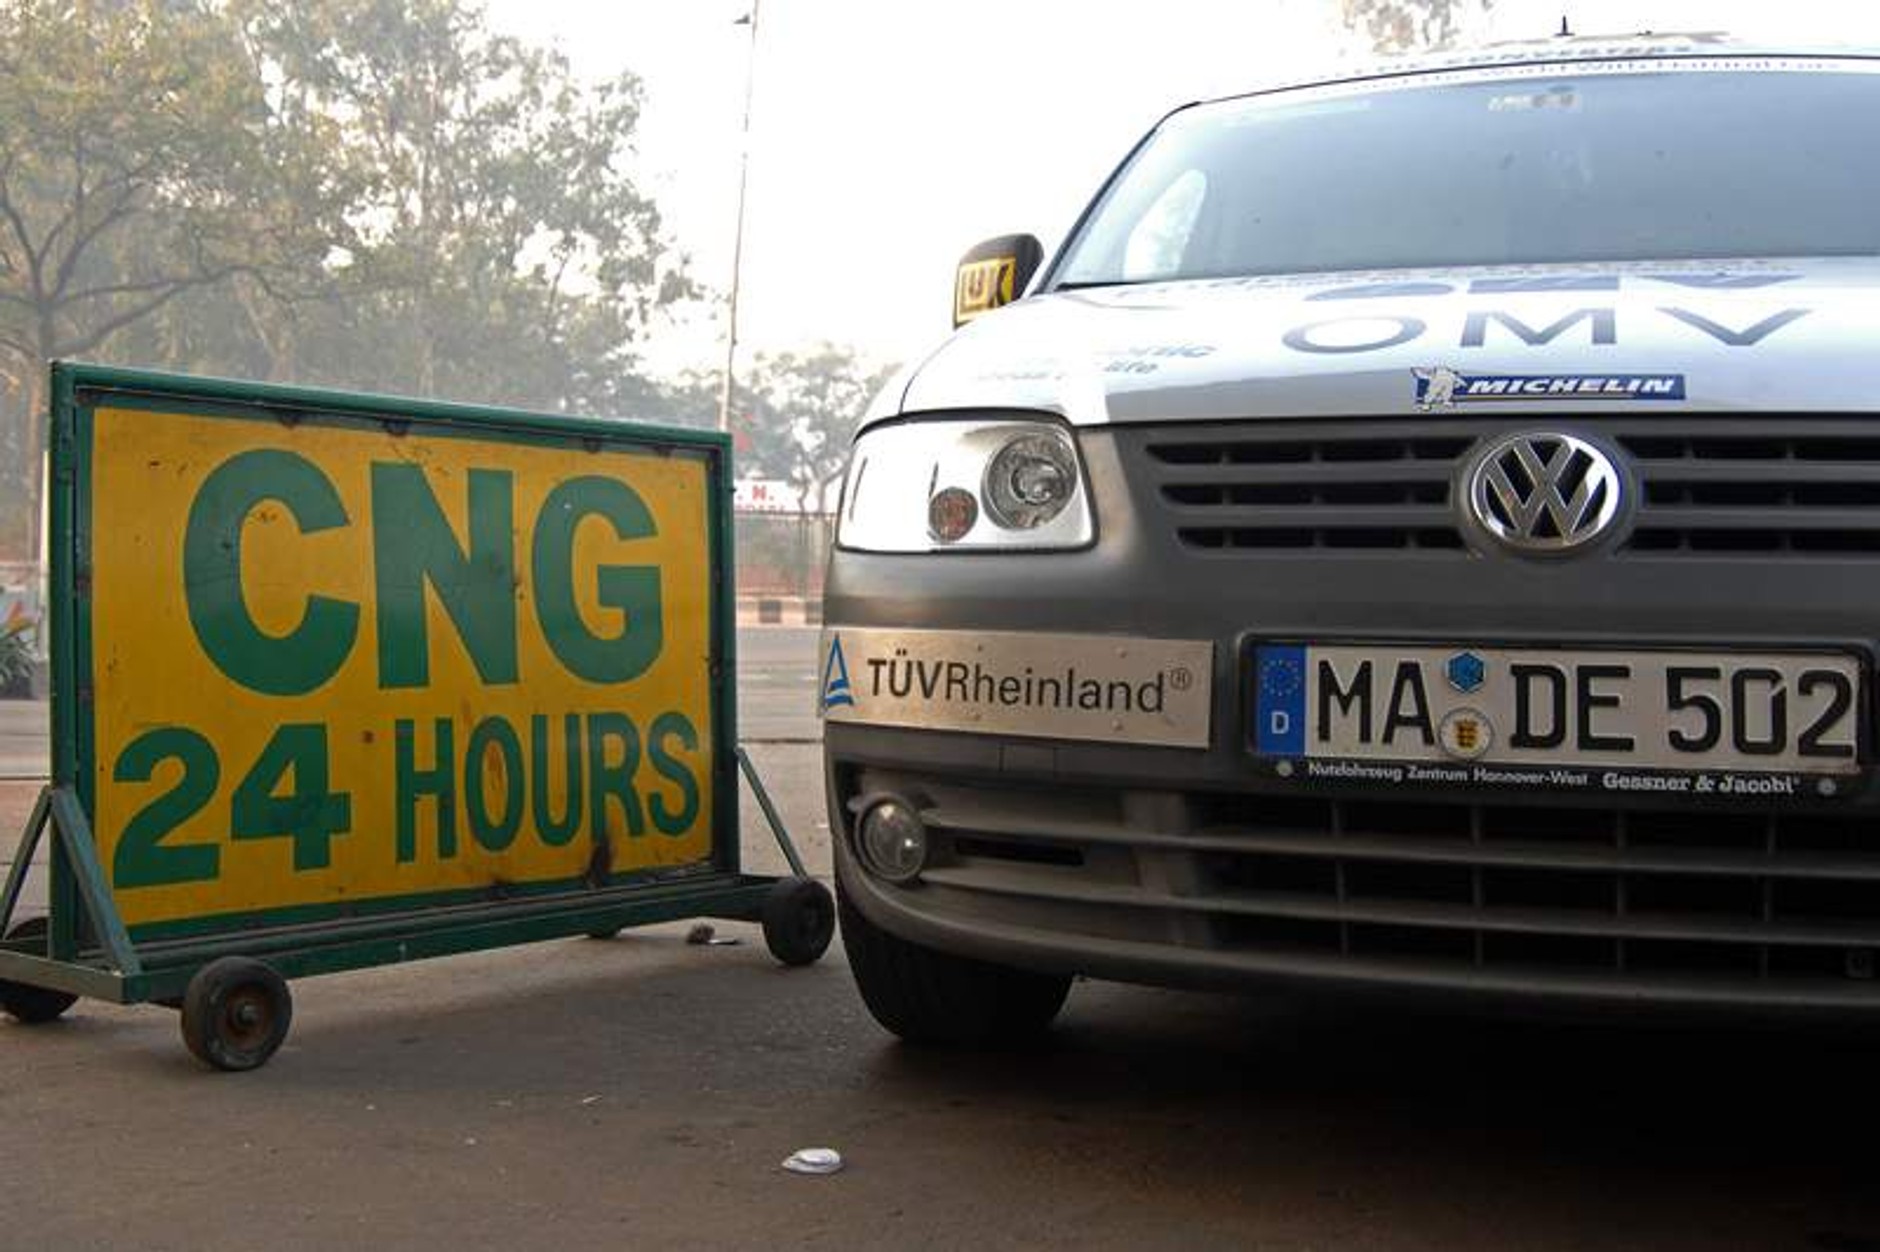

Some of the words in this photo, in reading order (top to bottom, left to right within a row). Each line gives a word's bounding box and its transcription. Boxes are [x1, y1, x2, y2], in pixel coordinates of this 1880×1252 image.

[1281, 307, 1814, 353] OMV
[1467, 377, 1675, 395] MICHELIN
[183, 448, 664, 697] CNG
[1270, 711, 1290, 735] D
[1317, 659, 1435, 745] MA
[1509, 664, 1635, 751] DE
[1665, 667, 1854, 758] 502
[112, 723, 352, 889] 24
[395, 711, 700, 864] HOURS
[1603, 771, 1691, 791] Gessner
[1695, 775, 1714, 793] &
